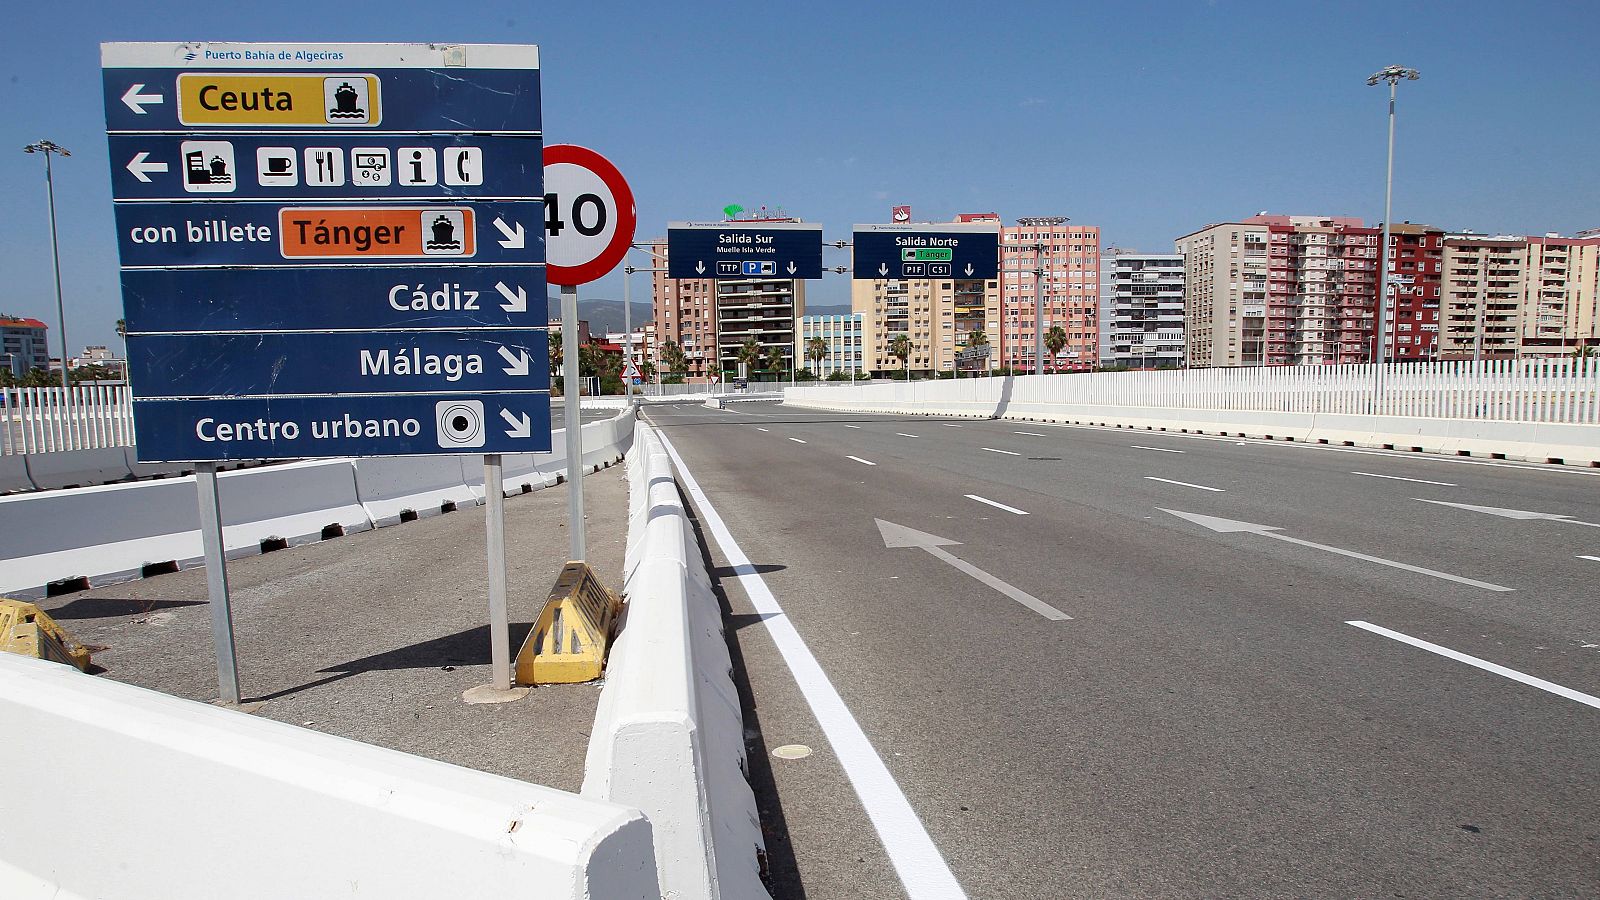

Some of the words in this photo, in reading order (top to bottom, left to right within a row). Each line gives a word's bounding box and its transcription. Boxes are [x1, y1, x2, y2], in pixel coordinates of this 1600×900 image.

[205, 50, 242, 61] Puerto
[245, 50, 275, 61] Bahía
[278, 50, 292, 61] de
[295, 50, 344, 64] Algeciras
[199, 85, 293, 112] Ceuta
[544, 193, 607, 237] 40
[131, 226, 177, 244] con
[187, 220, 272, 243] billete
[293, 220, 405, 252] Tánger
[719, 233, 752, 244] Salida
[755, 234, 774, 244] Sur
[895, 236, 927, 247] Salida
[929, 237, 959, 247] Norte
[907, 266, 922, 274] PIF
[932, 266, 947, 274] CSI
[388, 283, 480, 311] Cádiz
[360, 347, 483, 381] Málaga
[196, 418, 299, 441] Centro
[311, 413, 420, 439] urbano
